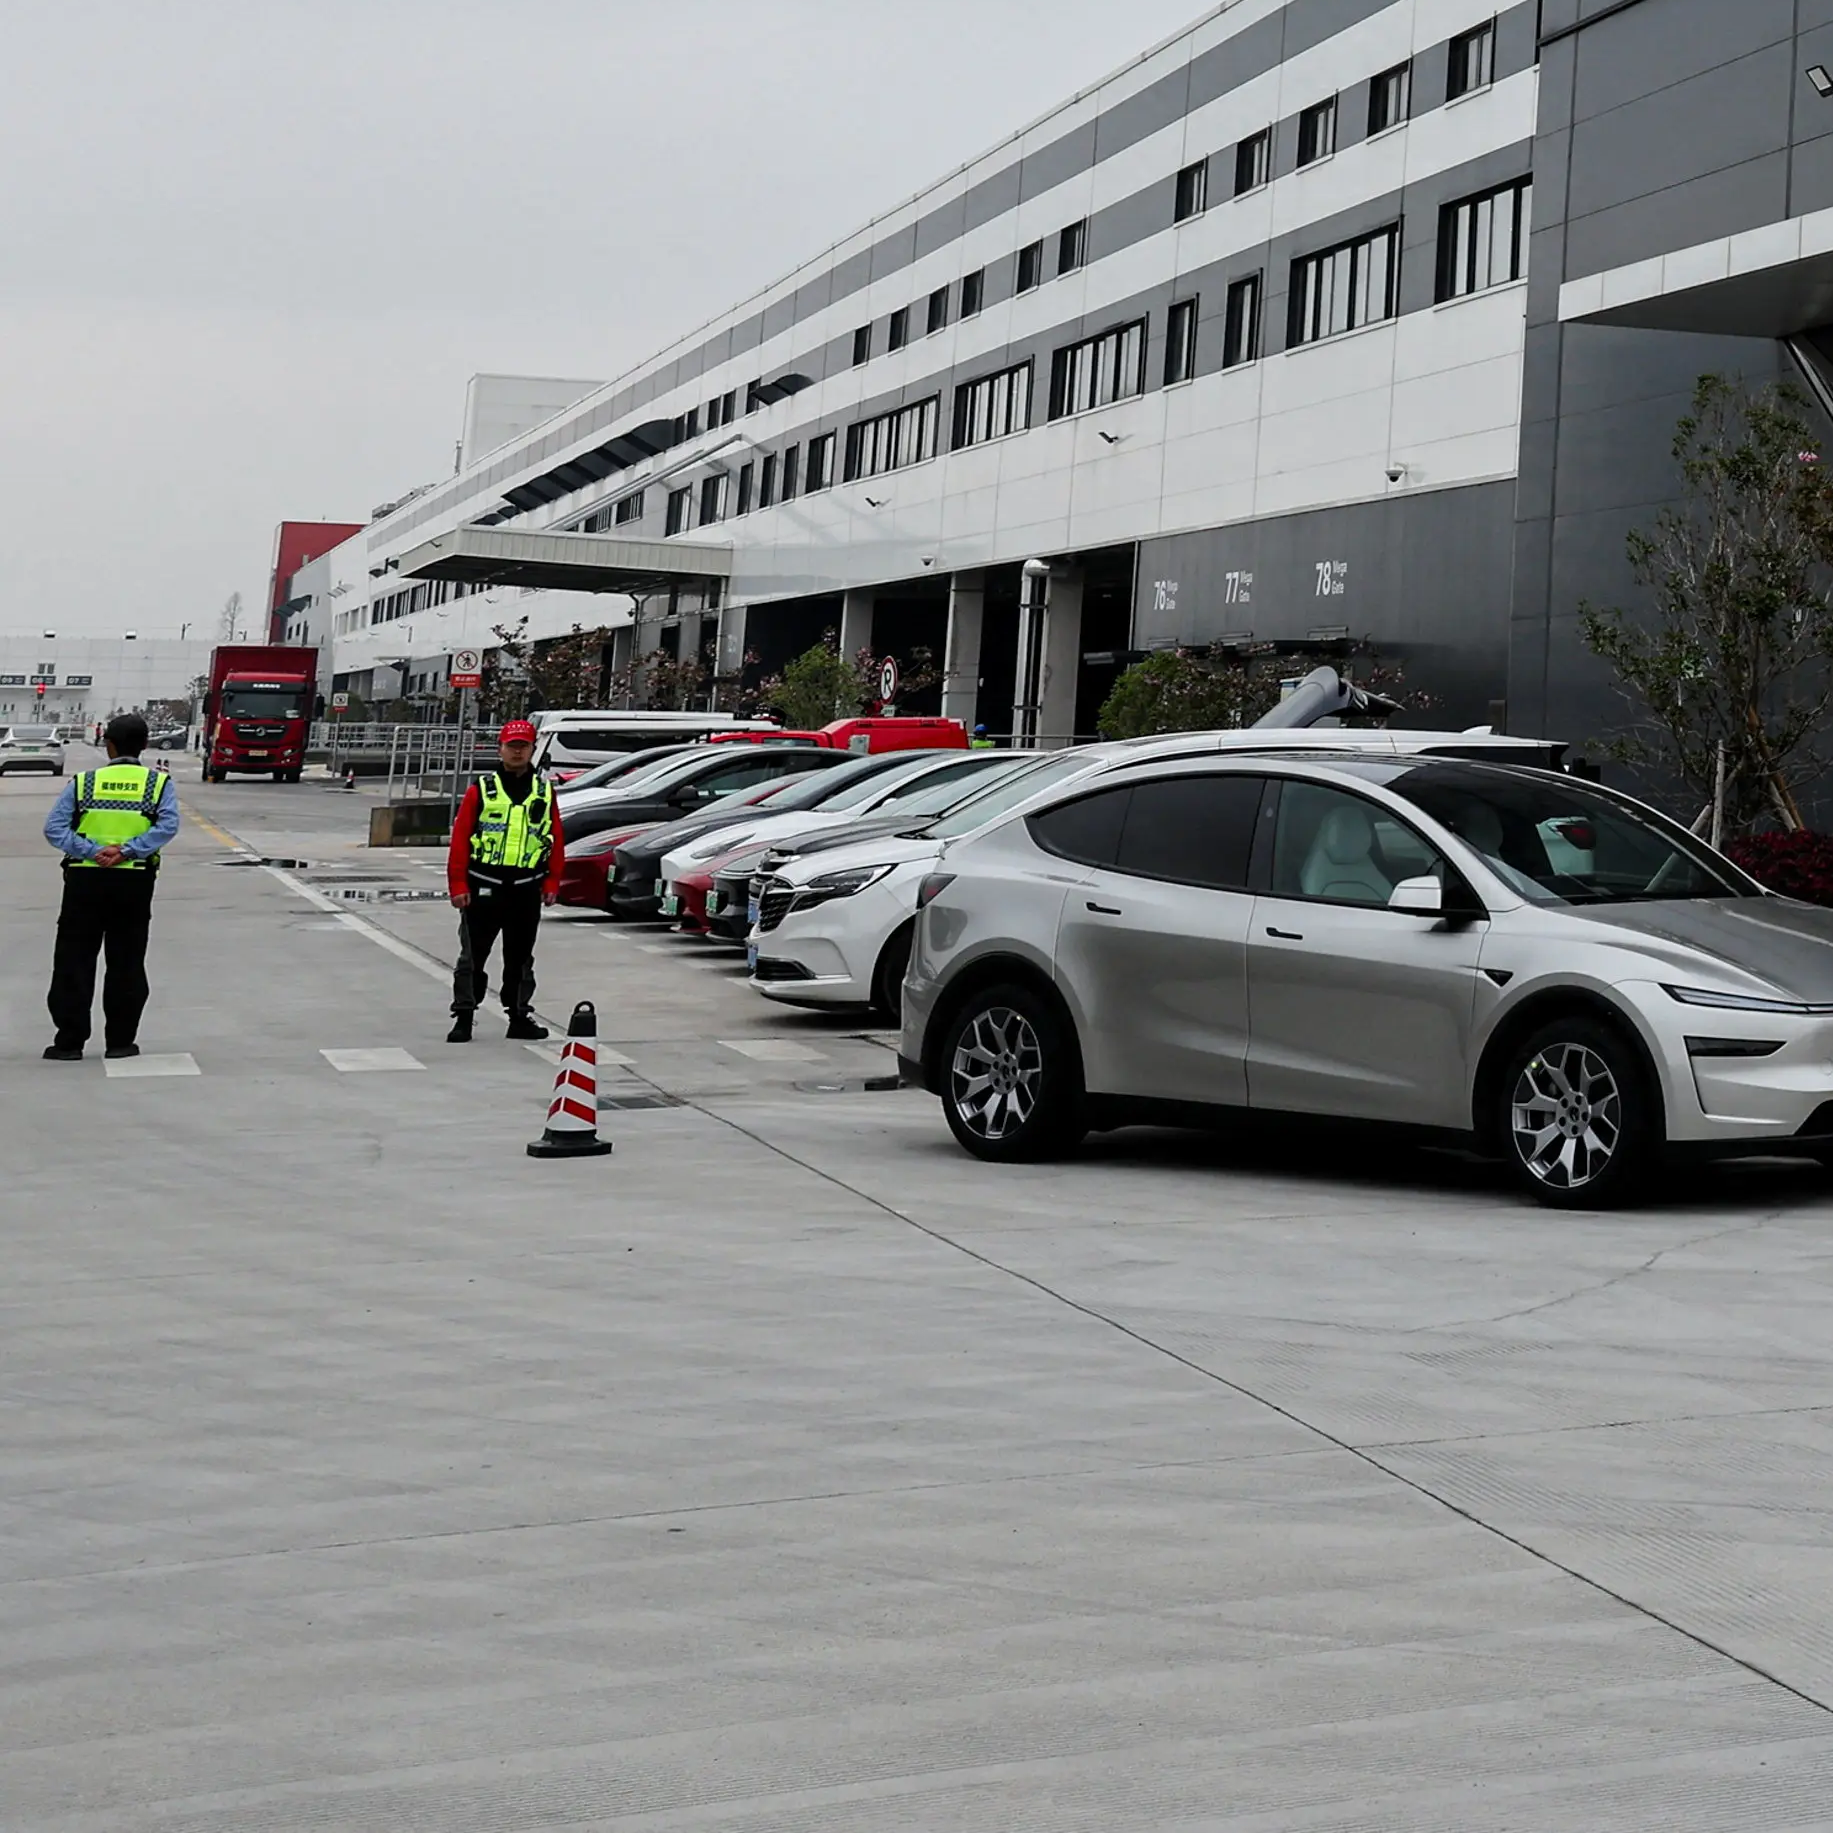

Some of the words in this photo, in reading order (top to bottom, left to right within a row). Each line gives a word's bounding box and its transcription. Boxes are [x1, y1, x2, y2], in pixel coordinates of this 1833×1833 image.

[1315, 561, 1332, 596] 78
[1332, 560, 1348, 577] Mega
[1153, 580, 1167, 611] 76
[1225, 571, 1239, 604] 77
